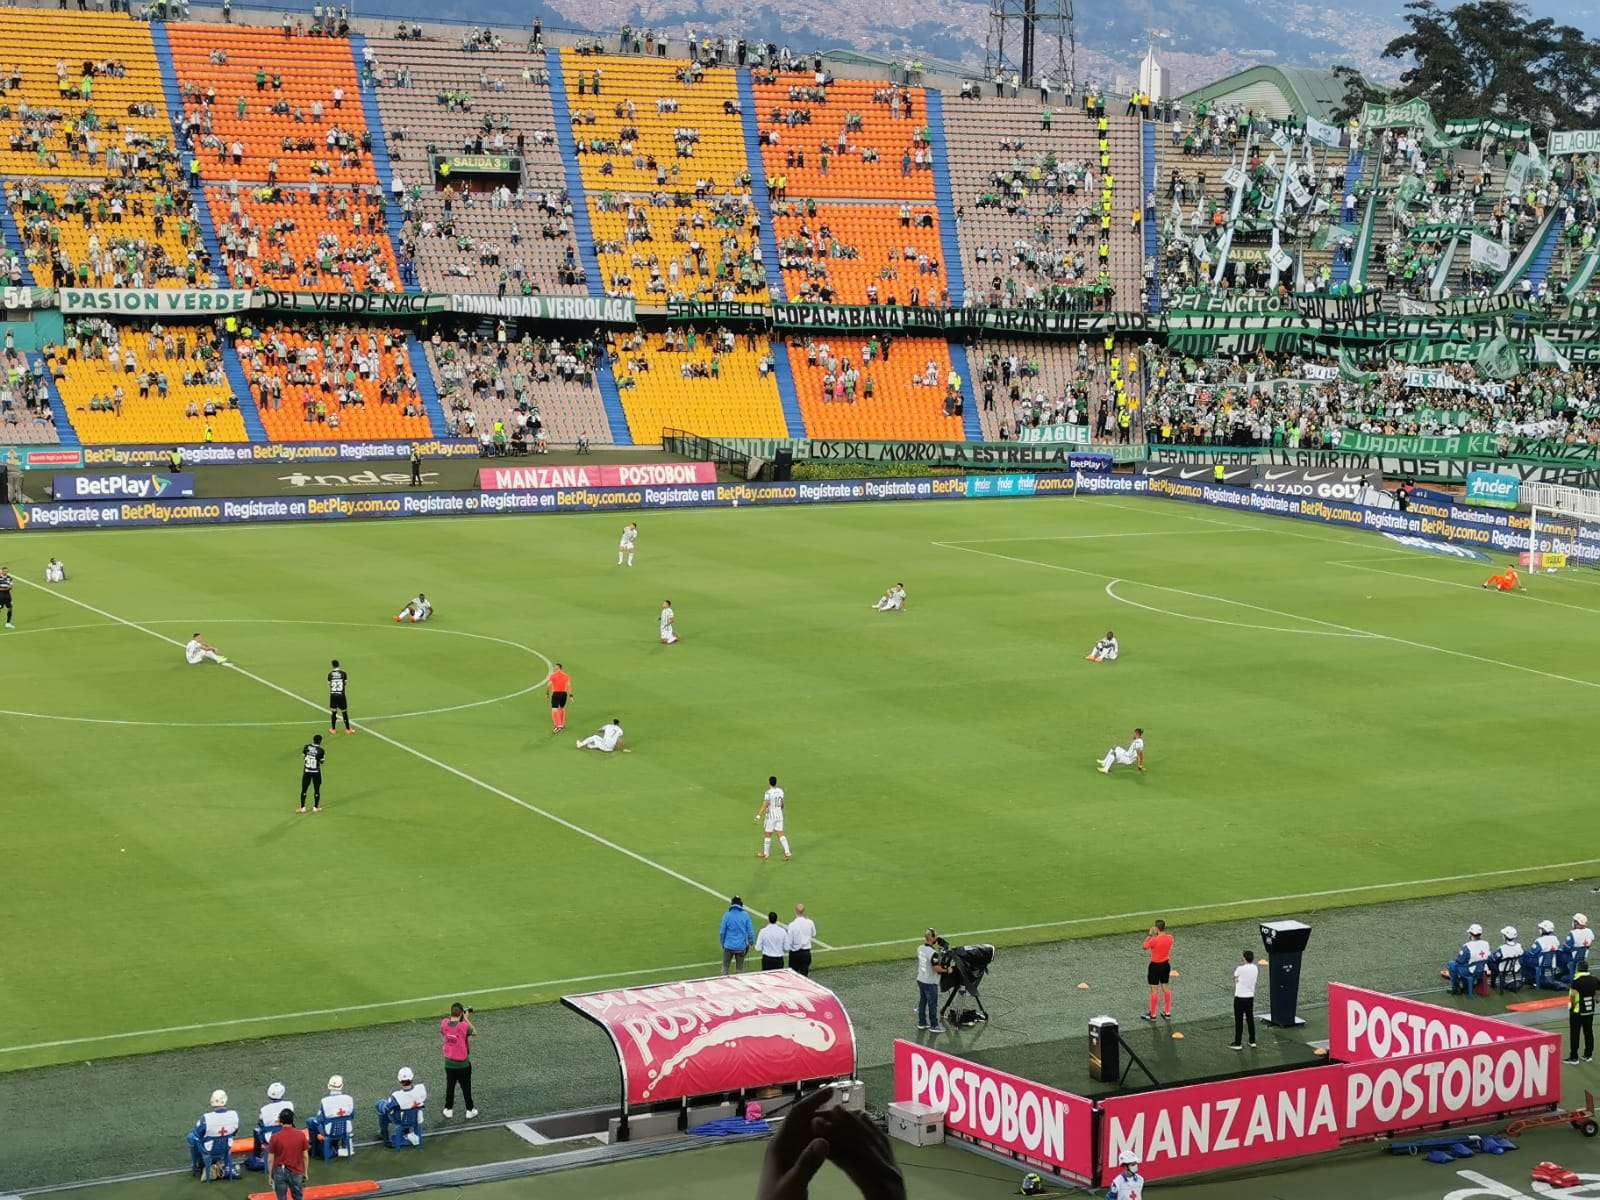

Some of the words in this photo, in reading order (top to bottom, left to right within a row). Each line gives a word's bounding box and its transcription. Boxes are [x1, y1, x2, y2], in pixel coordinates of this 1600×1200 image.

[4, 286, 33, 309] 54
[66, 291, 160, 311] PASION
[164, 291, 246, 311] VERDE
[264, 290, 303, 310] DEL
[452, 294, 542, 317] COMUNIDAD
[546, 298, 633, 323] VERDOLAGA
[773, 303, 902, 329] COPACABANA
[992, 309, 1103, 334] ARANJUEZ
[1023, 424, 1087, 443] IBAGUE
[1341, 430, 1460, 455] CUADRILLA
[253, 443, 337, 462] BetPlay.com.co
[843, 443, 875, 461] DEL
[879, 443, 936, 462] MORRO
[972, 445, 1068, 465] ESTRELLA
[75, 474, 150, 496] BetPlay
[495, 466, 590, 490] MANZANA
[618, 465, 697, 485] POSTOBON
[31, 504, 99, 524] Regístrate
[101, 507, 119, 520] en
[120, 501, 220, 520] BetPlay.com.co
[224, 499, 287, 519] Regístrate
[289, 500, 306, 514] en
[308, 496, 401, 516] BetPlay.com.co
[404, 493, 462, 512] Regístrate
[480, 491, 537, 510] Regístrate
[540, 493, 555, 506] en
[557, 488, 641, 508] BetPlay.com.co
[645, 486, 699, 505] Regístrate
[701, 488, 715, 501] en
[717, 484, 796, 503] BetPlay.com.co
[800, 481, 850, 500] Regístrate
[866, 479, 915, 498] Regístrate
[917, 482, 931, 494] en
[1251, 493, 1288, 513] Regístrate
[1289, 502, 1300, 513] en
[1301, 500, 1362, 523] BetPlay.com.co
[1364, 510, 1408, 532] Regístrate
[1409, 518, 1421, 532] en
[1421, 517, 1489, 544] BetPlay.com.co
[331, 680, 343, 692] 23
[911, 1052, 1067, 1162] POSTOBON
[1108, 1083, 1338, 1169] MANZANA
[1346, 1043, 1549, 1129] POSTOBON
